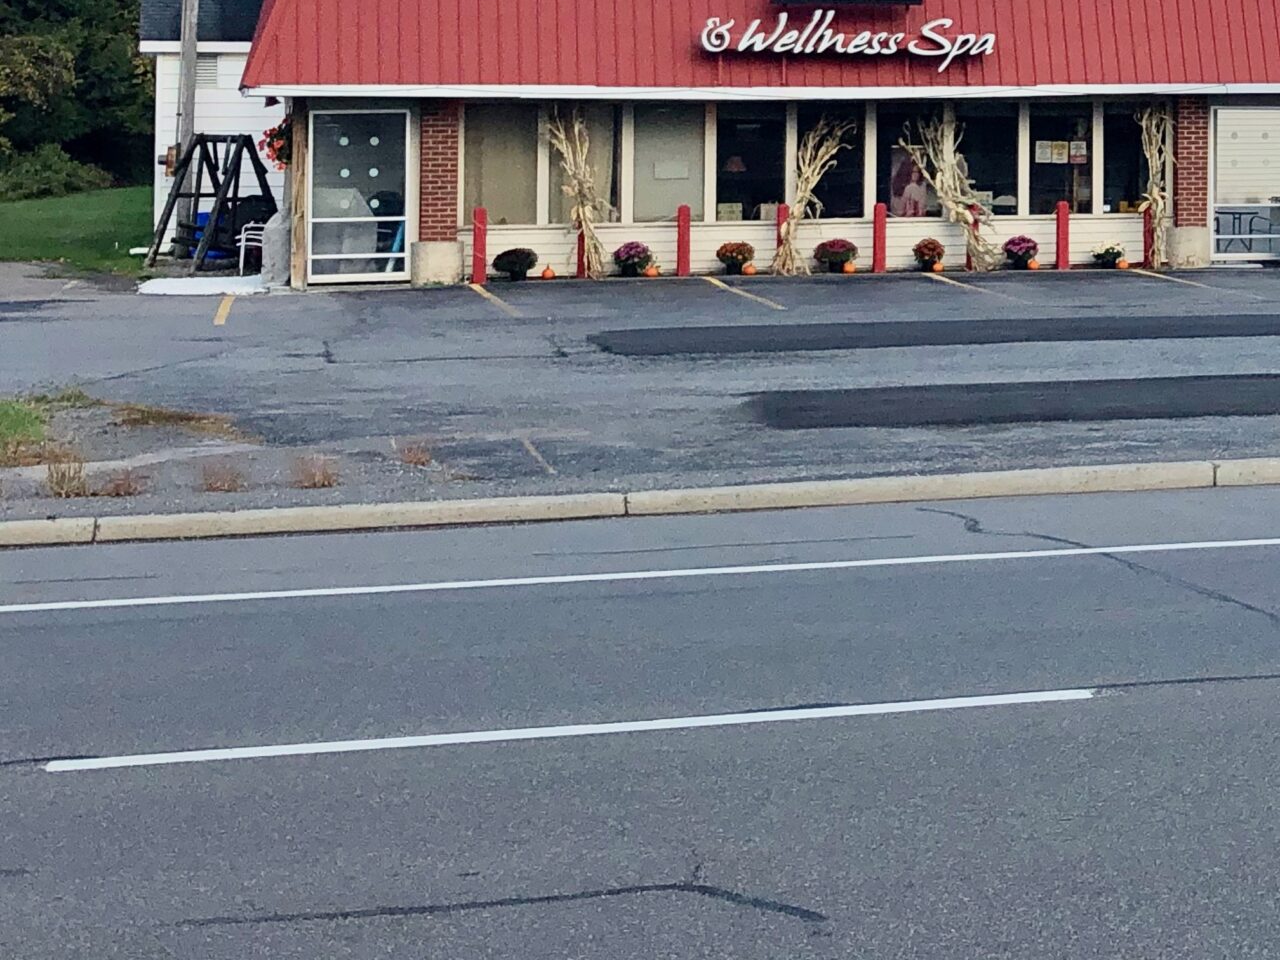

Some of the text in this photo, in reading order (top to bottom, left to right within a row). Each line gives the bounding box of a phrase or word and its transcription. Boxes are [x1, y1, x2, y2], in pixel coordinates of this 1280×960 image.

[701, 9, 996, 73] & Wellness Spa
